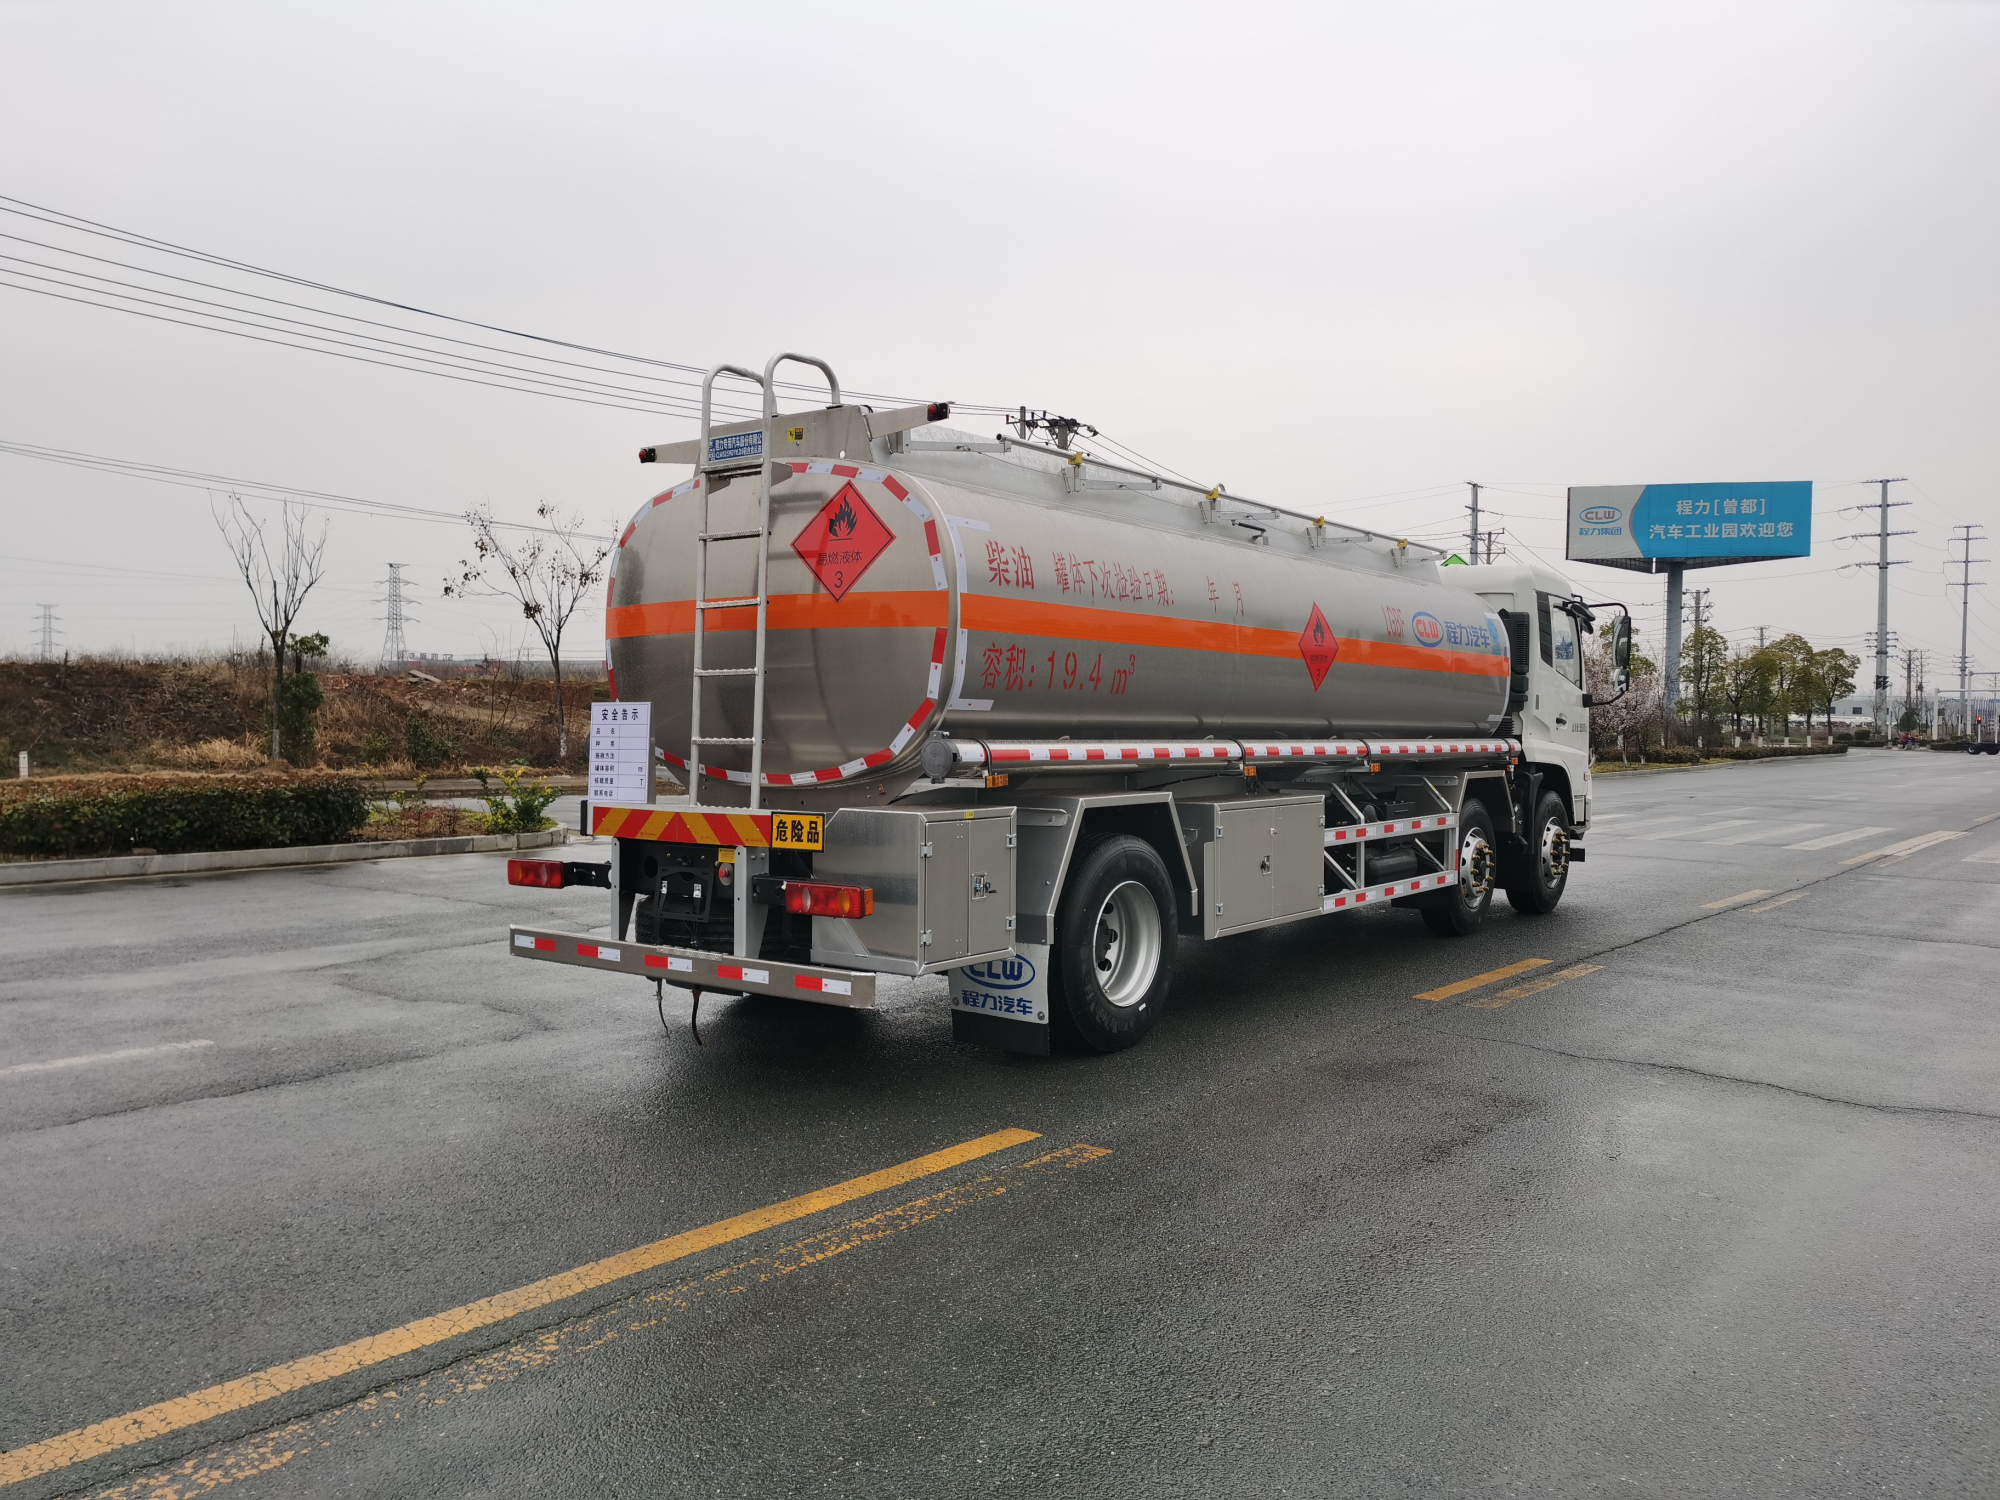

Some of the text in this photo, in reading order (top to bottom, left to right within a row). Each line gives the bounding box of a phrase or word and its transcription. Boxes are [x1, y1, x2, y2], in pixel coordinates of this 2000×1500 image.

[1584, 510, 1616, 521] CLW
[1676, 498, 1766, 516] 程力[曾都]
[1578, 527, 1622, 536] 程力集团
[1649, 521, 1794, 540] 汽车工业园欢迎您
[817, 550, 862, 566] 易燃液体
[985, 539, 1035, 590] 柴油
[834, 571, 843, 588] 3
[1415, 618, 1440, 640] CLW
[1443, 620, 1491, 649] 程力汽车
[601, 708, 639, 721] 安全告示
[775, 818, 820, 844] 危险品
[961, 989, 1033, 1015] 程力汽车
